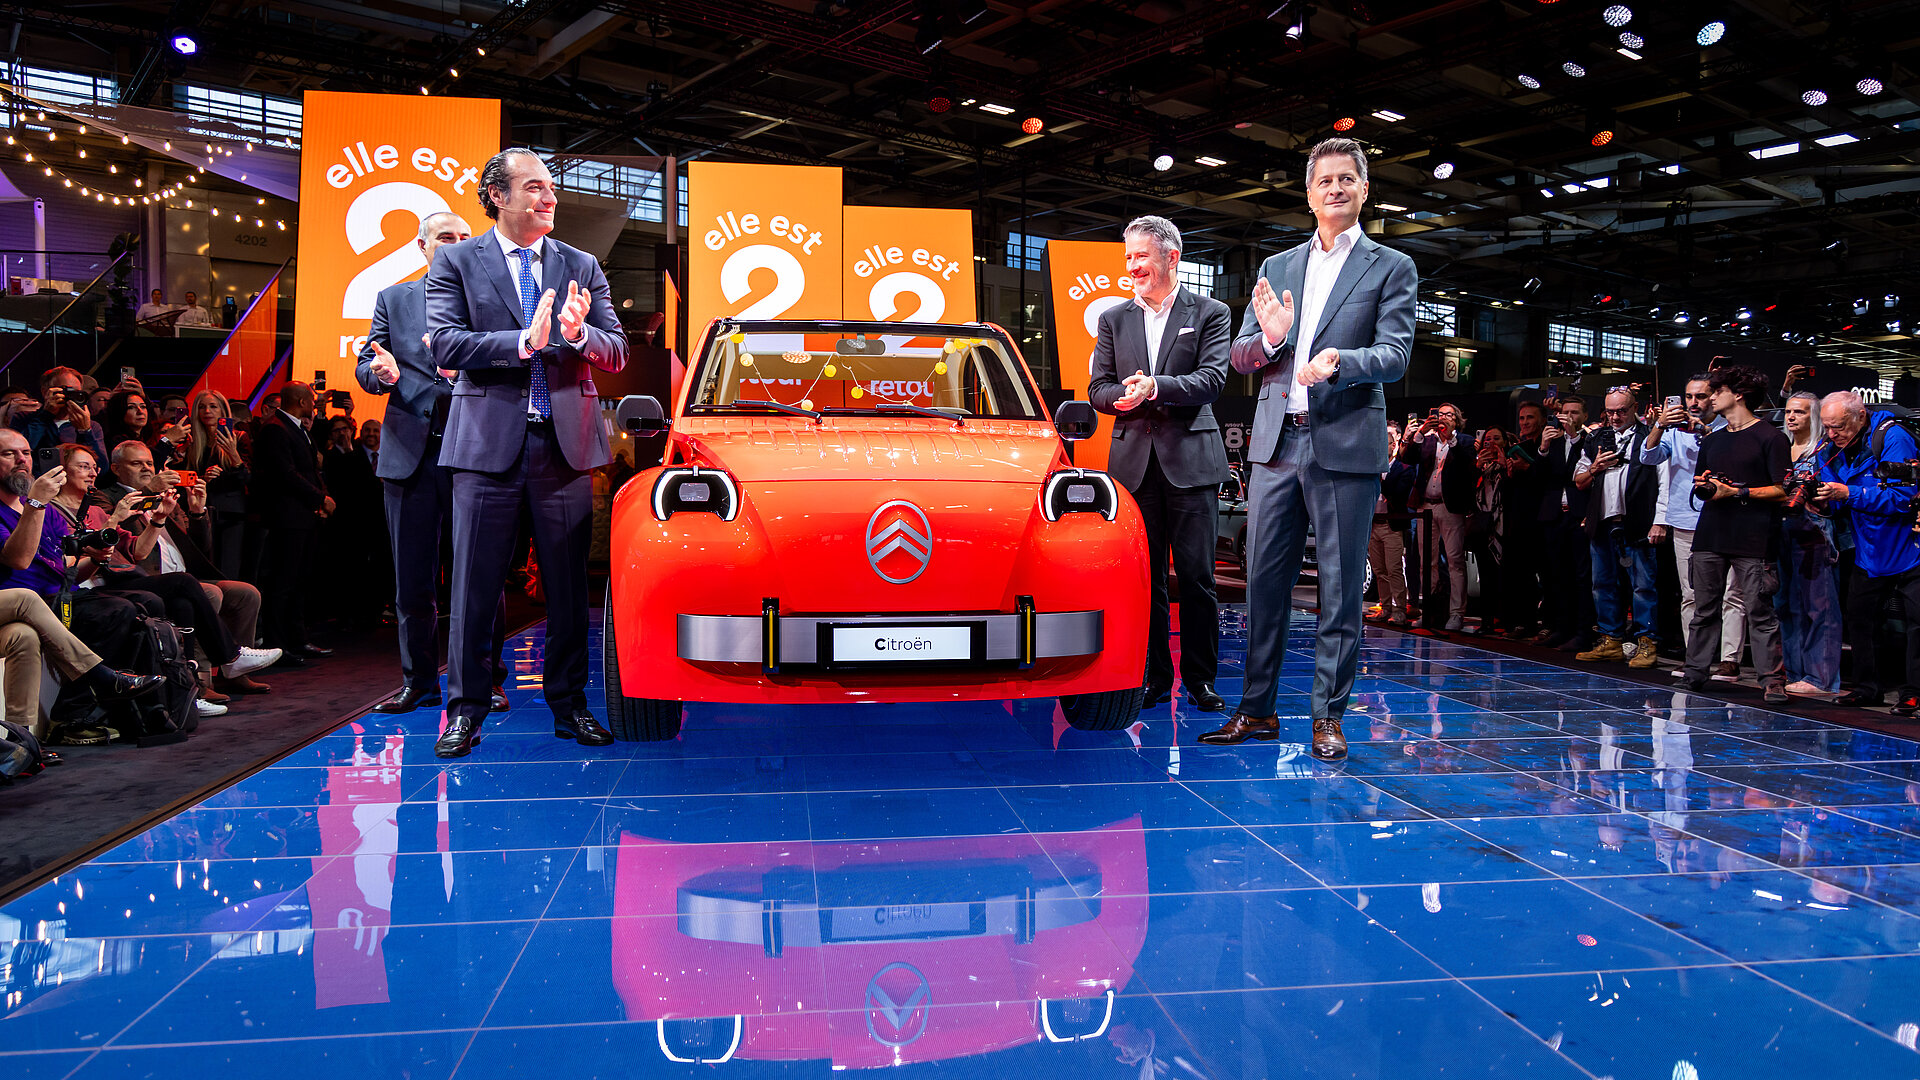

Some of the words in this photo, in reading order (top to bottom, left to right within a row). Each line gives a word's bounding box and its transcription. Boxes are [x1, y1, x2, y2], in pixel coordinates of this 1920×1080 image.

[326, 141, 400, 189] elle
[411, 147, 479, 196] est
[235, 233, 268, 248] 4202
[704, 210, 761, 251] elle
[769, 215, 823, 256] est
[342, 181, 453, 320] 2
[853, 244, 904, 278] elle
[911, 248, 960, 281] est
[1068, 272, 1111, 301] elle
[870, 379, 934, 398] retou
[1225, 427, 1244, 448] 8
[874, 636, 932, 651] Citroën
